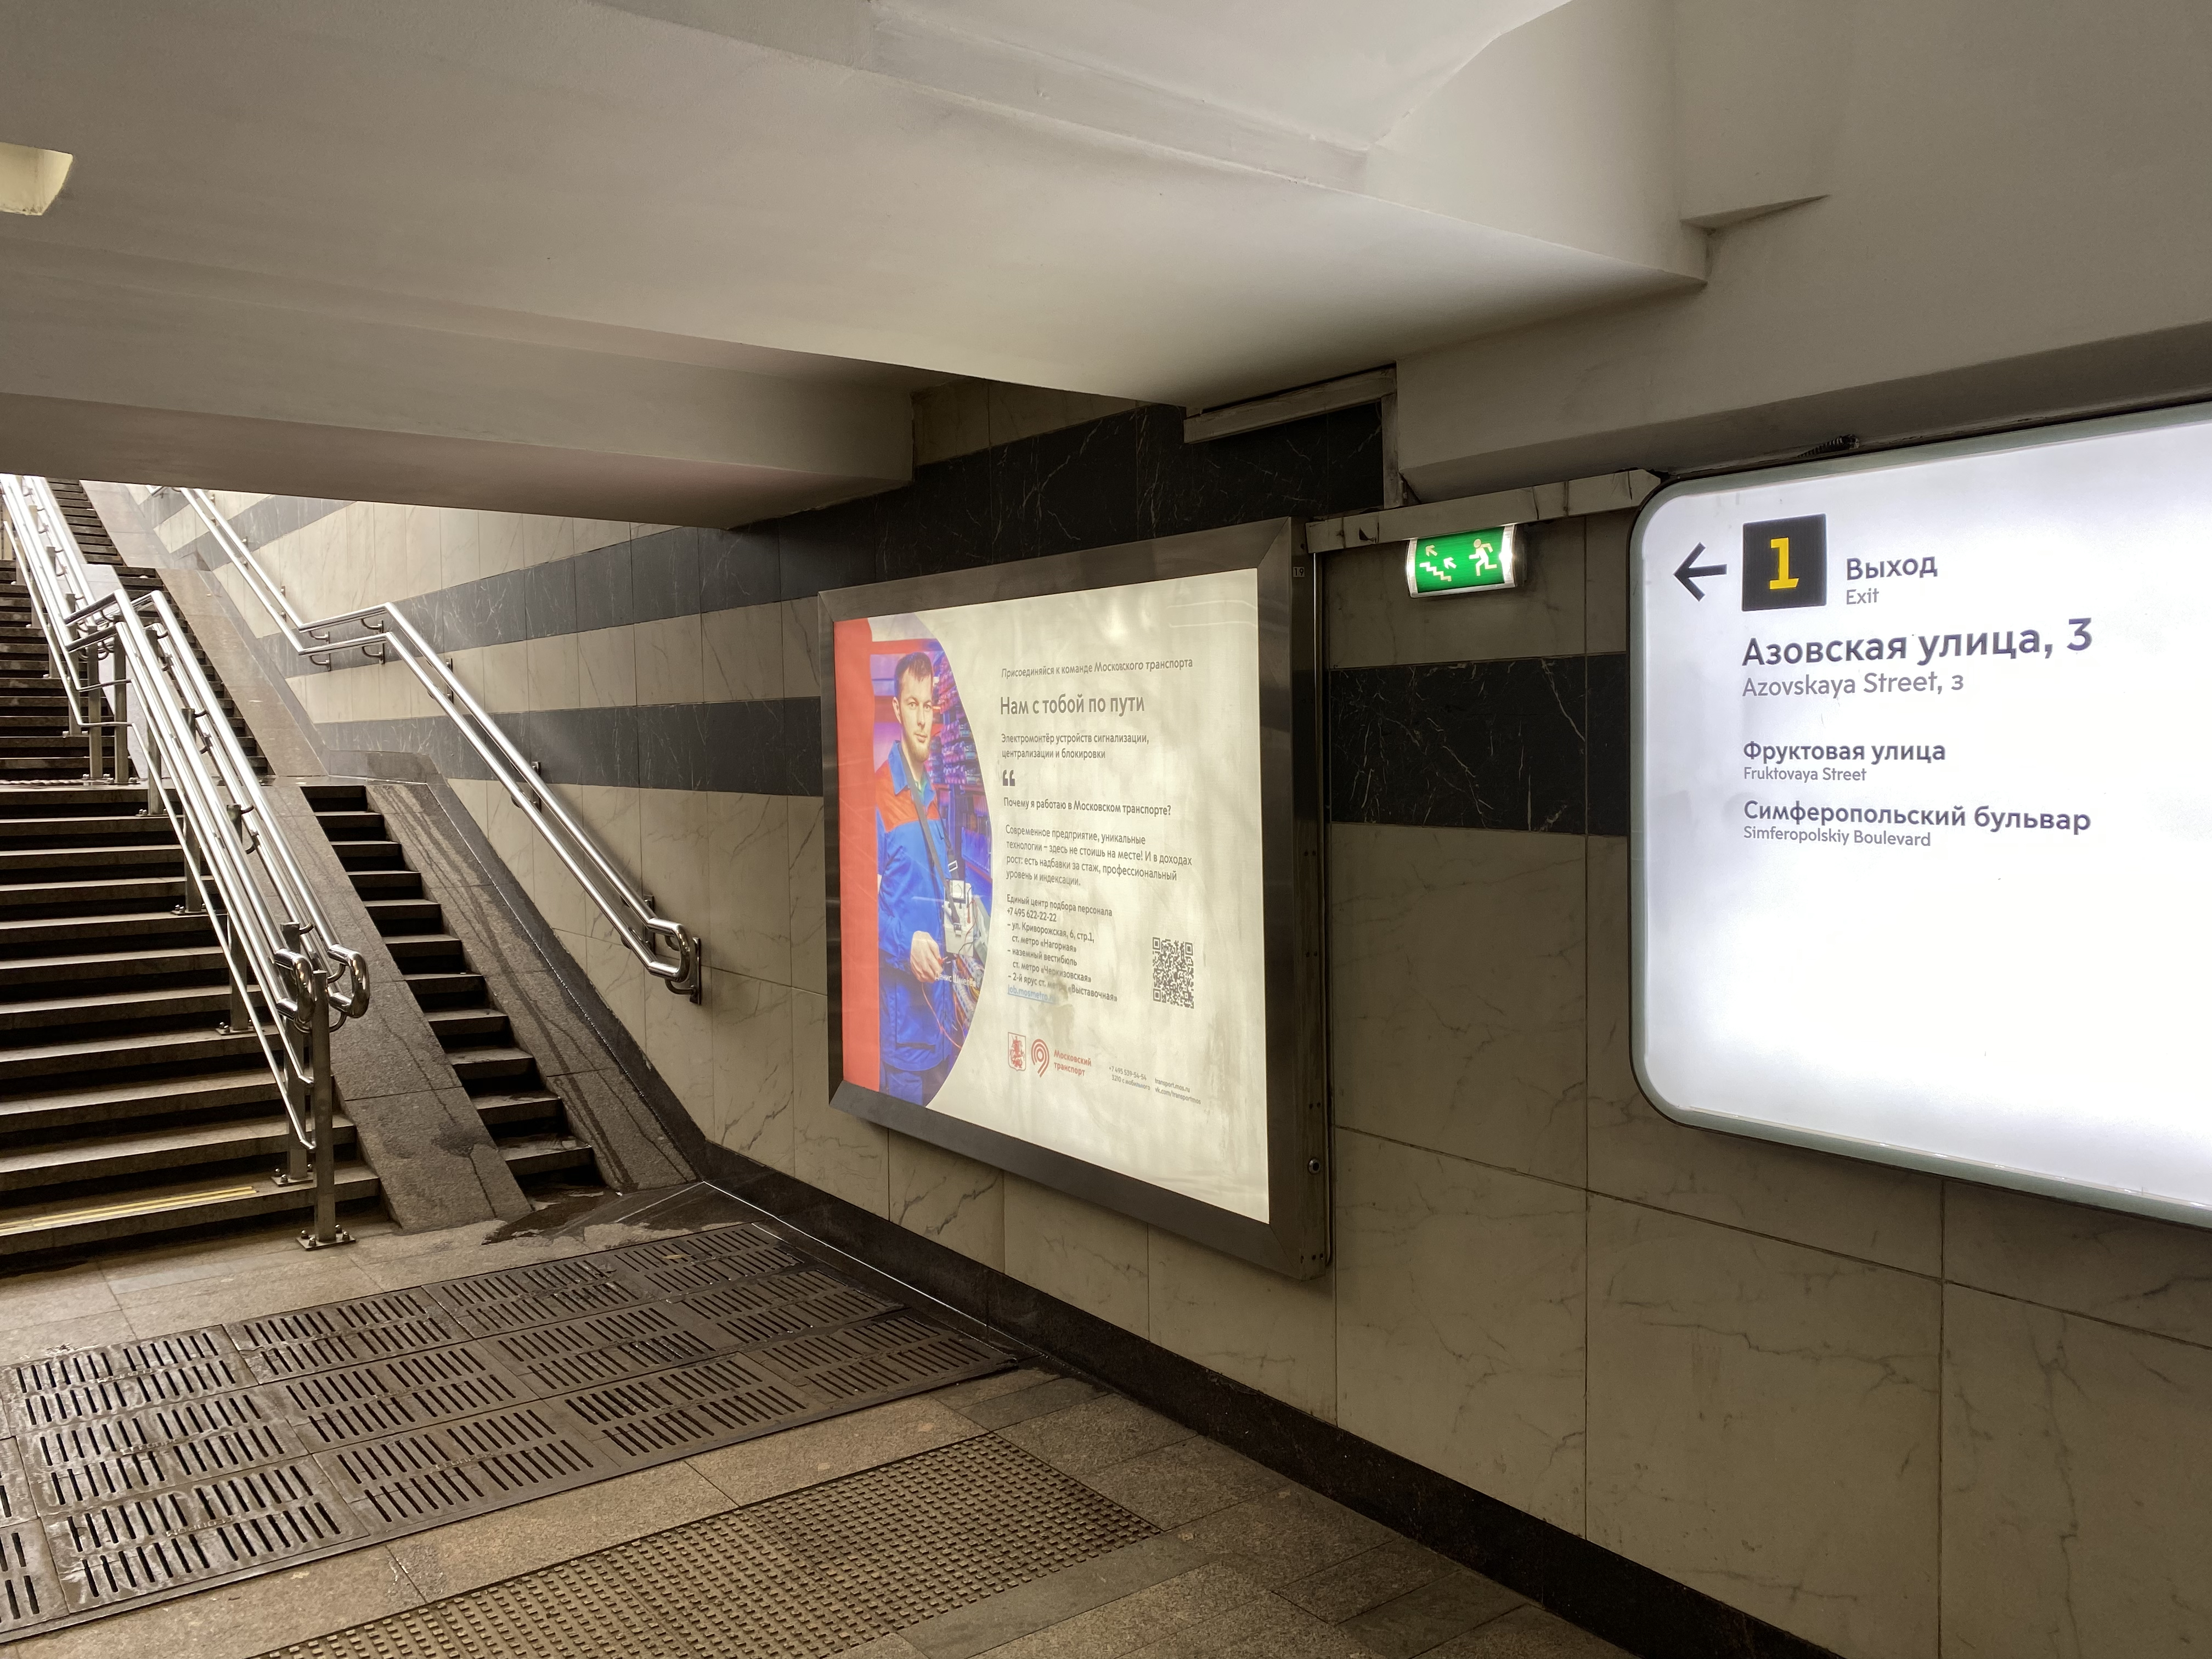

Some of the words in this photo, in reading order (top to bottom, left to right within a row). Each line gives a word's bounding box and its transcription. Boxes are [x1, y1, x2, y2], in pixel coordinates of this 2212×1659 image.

[1294, 567, 1304, 576] 19
[1769, 537, 1799, 590] 1
[1847, 556, 1938, 581] Выход
[1846, 587, 1879, 605] Exit
[1741, 636, 1908, 666] Азовская
[1916, 628, 2053, 666] улица,
[2066, 617, 2092, 651] 3
[1001, 666, 1054, 679] Присоединяйся
[1062, 664, 1093, 675] команде
[1094, 661, 1144, 673] Московского
[1146, 658, 1193, 672] транспорта
[1742, 674, 1856, 698] Azovskaya
[1863, 671, 1943, 695] Street,
[1000, 696, 1029, 715] Нам
[1032, 699, 1040, 714] с
[1042, 693, 1085, 714] тобой
[1088, 697, 1106, 713] по
[1110, 696, 1145, 717] пути
[1001, 733, 1054, 745] Электромонтёр
[1056, 732, 1092, 745] устройств
[1093, 734, 1149, 745] сигнализации,
[1002, 748, 1054, 759] централизации
[1055, 750, 1060, 758] и
[1062, 748, 1105, 760] блокировки
[1743, 741, 1865, 765] Фруктовая
[1871, 744, 1946, 765] улица
[1743, 766, 1819, 783] Fruktovaya
[1822, 768, 1866, 781] Street
[1003, 797, 1029, 810] Почему
[1030, 799, 1035, 808] я
[1036, 799, 1066, 811] работаю
[1068, 801, 1072, 810] в
[1073, 800, 1121, 813] Московском
[1122, 804, 1171, 817] транспорте?
[1743, 800, 1966, 827] Симферопольский
[1974, 805, 2091, 836] бульвар
[1006, 825, 1051, 837] Современное
[1052, 829, 1099, 842] предприятие,
[1101, 833, 1146, 845] уникальные
[1743, 826, 1850, 847] Simferopolskiy
[1853, 830, 1931, 847] Boulevard
[1006, 841, 1042, 852] технологии
[1049, 845, 1068, 855] здесь
[1069, 846, 1078, 855] не
[1079, 847, 1105, 858] стоишь
[1107, 850, 1116, 859] на
[1118, 850, 1143, 861] месте!
[1145, 851, 1152, 861] И
[1153, 854, 1158, 862] в
[1159, 854, 1193, 866] доходах
[1006, 855, 1023, 865] рост:
[1024, 856, 1039, 866] есть
[1040, 857, 1071, 870] надбавки
[1072, 861, 1080, 871] за
[1081, 863, 1101, 874] стаж,
[1102, 864, 1177, 881] профессиональный
[1006, 870, 1032, 881] уровень
[1034, 872, 1038, 881] и
[1040, 873, 1081, 886] индексации.
[1007, 894, 1029, 905] Единый
[1031, 899, 1048, 909] центр
[1049, 900, 1076, 912] подбора
[1077, 905, 1113, 917] персонала
[1007, 907, 1014, 916] +7
[1014, 908, 1025, 917] 495
[1026, 910, 1057, 922] 622-22-22
[1012, 922, 1020, 931] ул.
[1022, 921, 1068, 939] Криворожская,
[1069, 929, 1076, 940] 6,
[1020, 936, 1039, 947] метро
[1040, 938, 1077, 953] «Нагорная»
[1012, 948, 1042, 960] наземный
[1043, 953, 1077, 966] вестибюль
[935, 971, 952, 983] Денис
[1021, 963, 1040, 973] метро
[1041, 965, 1092, 983] «Черкизовская»
[1013, 972, 1023, 983] 2-й
[1024, 976, 1037, 986] ярус
[1068, 984, 1118, 1002] «Выставочная»
[1053, 1049, 1092, 1067] Московский
[1053, 1062, 1085, 1077] транспорт
[1115, 1066, 1124, 1075] 495
[1154, 1077, 1190, 1093] transport.mos.ru
[1154, 1086, 1201, 1105] vk.com/transportmos
